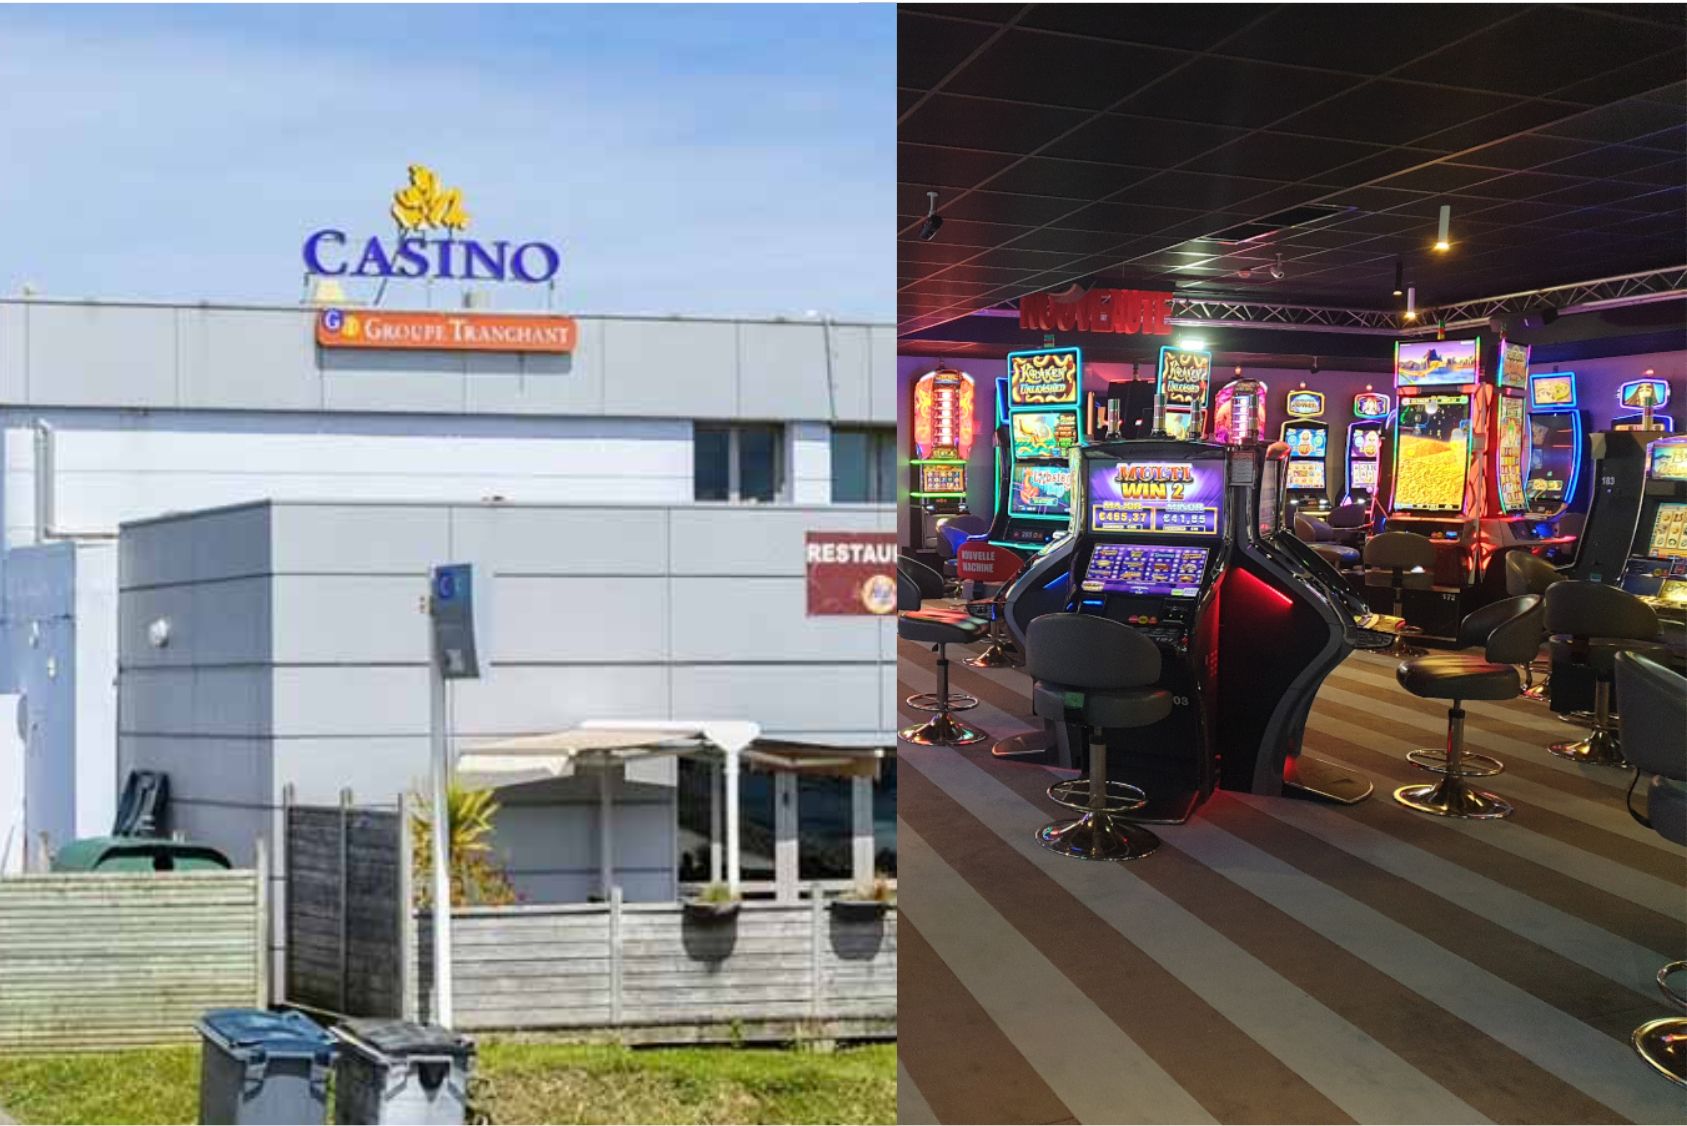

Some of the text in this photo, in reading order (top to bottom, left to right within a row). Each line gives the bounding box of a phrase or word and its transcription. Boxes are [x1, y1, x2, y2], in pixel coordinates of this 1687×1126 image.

[302, 229, 560, 283] CASINO
[364, 318, 569, 344] GROUPE TRANCHANT
[1115, 463, 1194, 482] MULTI
[1121, 482, 1185, 499] WIN 2
